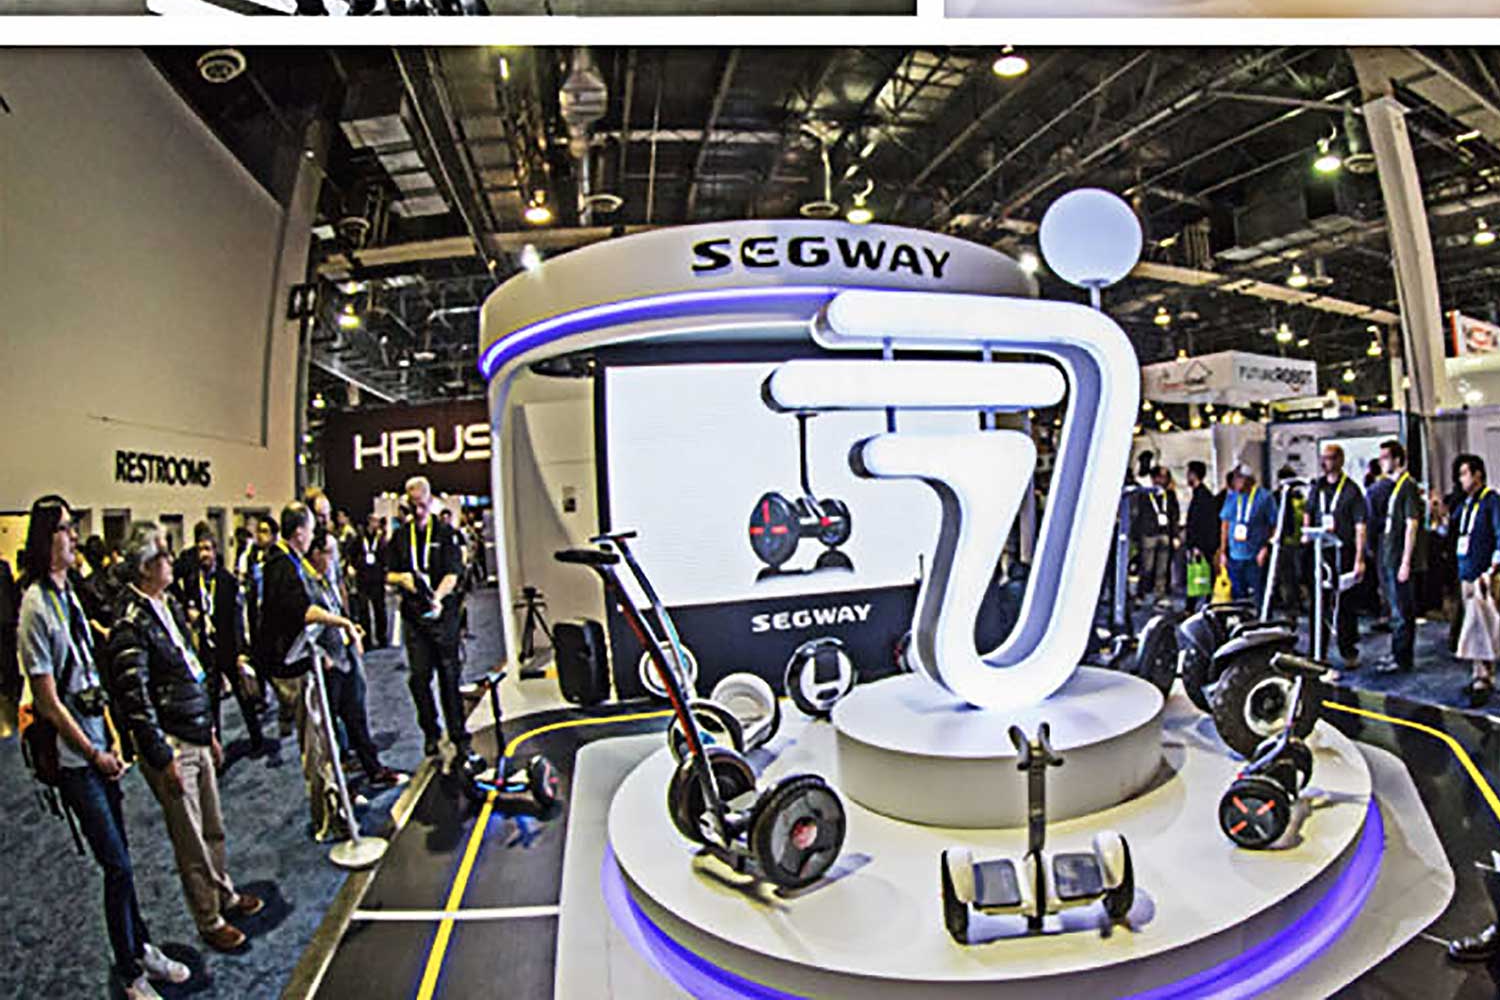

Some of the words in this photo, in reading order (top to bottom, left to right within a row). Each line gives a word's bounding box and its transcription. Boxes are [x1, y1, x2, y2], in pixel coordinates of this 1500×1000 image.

[691, 236, 950, 279] SEGWAY
[115, 450, 211, 488] RESTROOMS
[751, 603, 872, 632] SEGWAY
